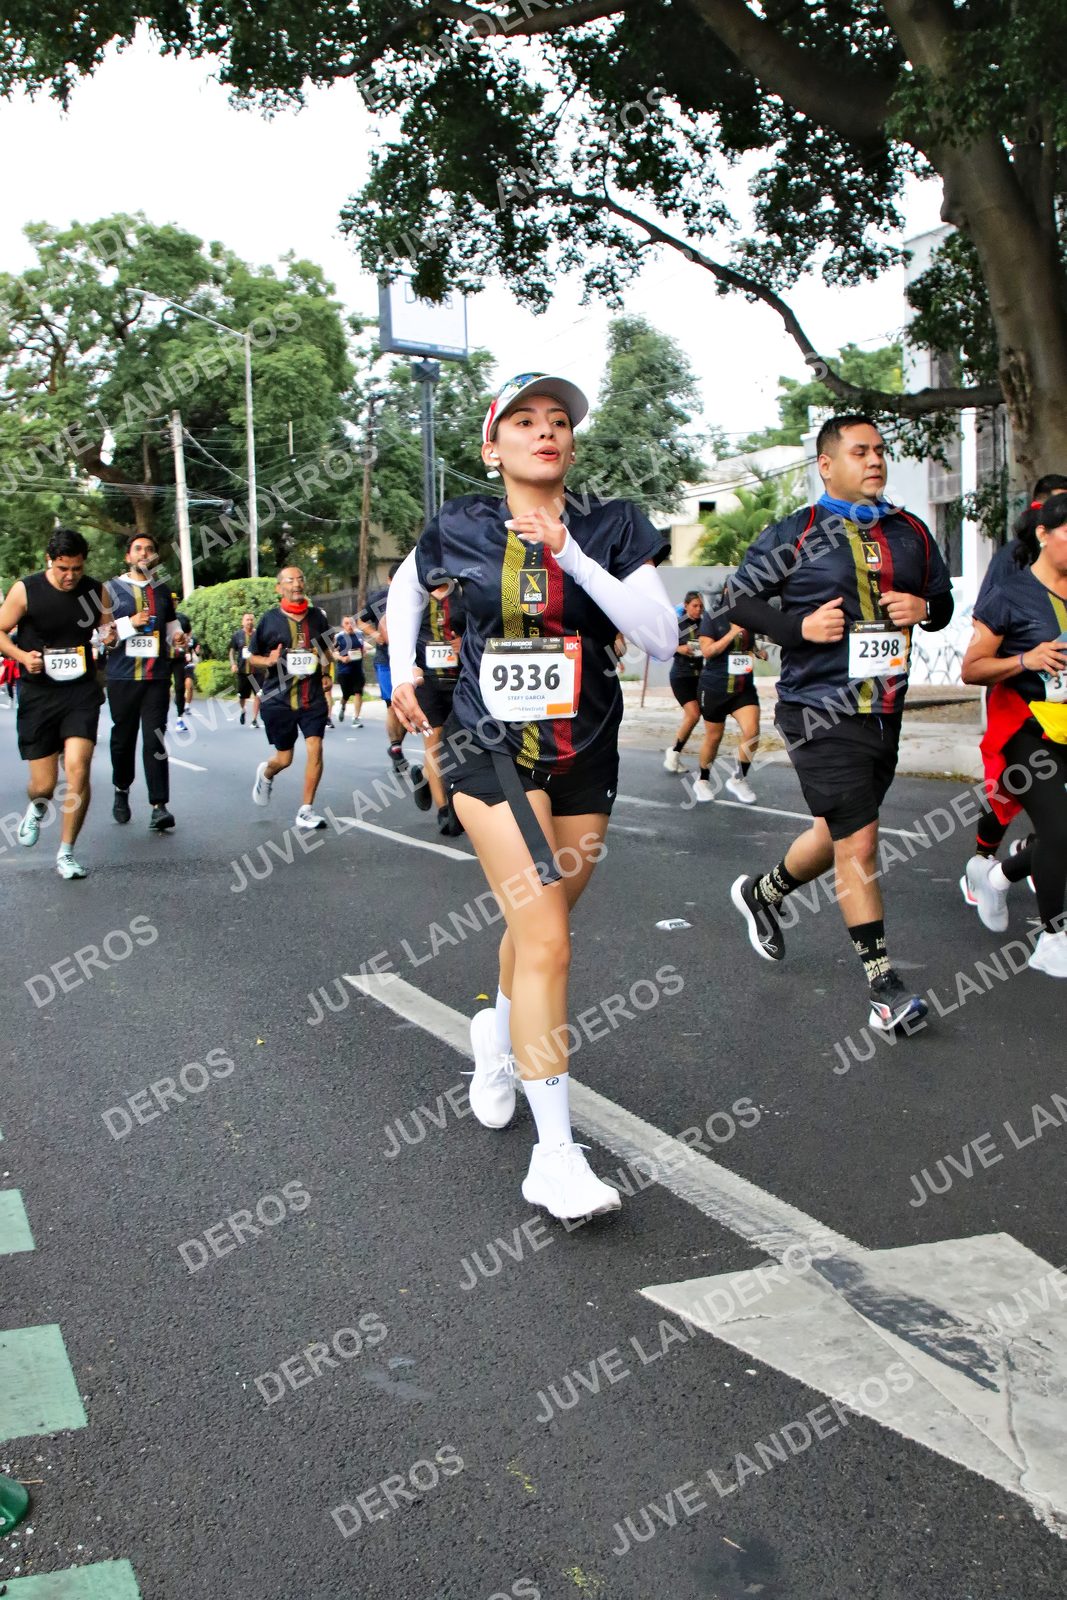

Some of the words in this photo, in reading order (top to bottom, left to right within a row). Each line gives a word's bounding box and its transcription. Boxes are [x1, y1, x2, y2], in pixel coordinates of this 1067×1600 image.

[131, 639, 152, 648] 5638
[859, 639, 900, 658] 2398
[431, 649, 453, 658] 7175
[51, 658, 78, 669] 5798
[292, 656, 312, 665] 2307
[492, 664, 560, 691] 9336
